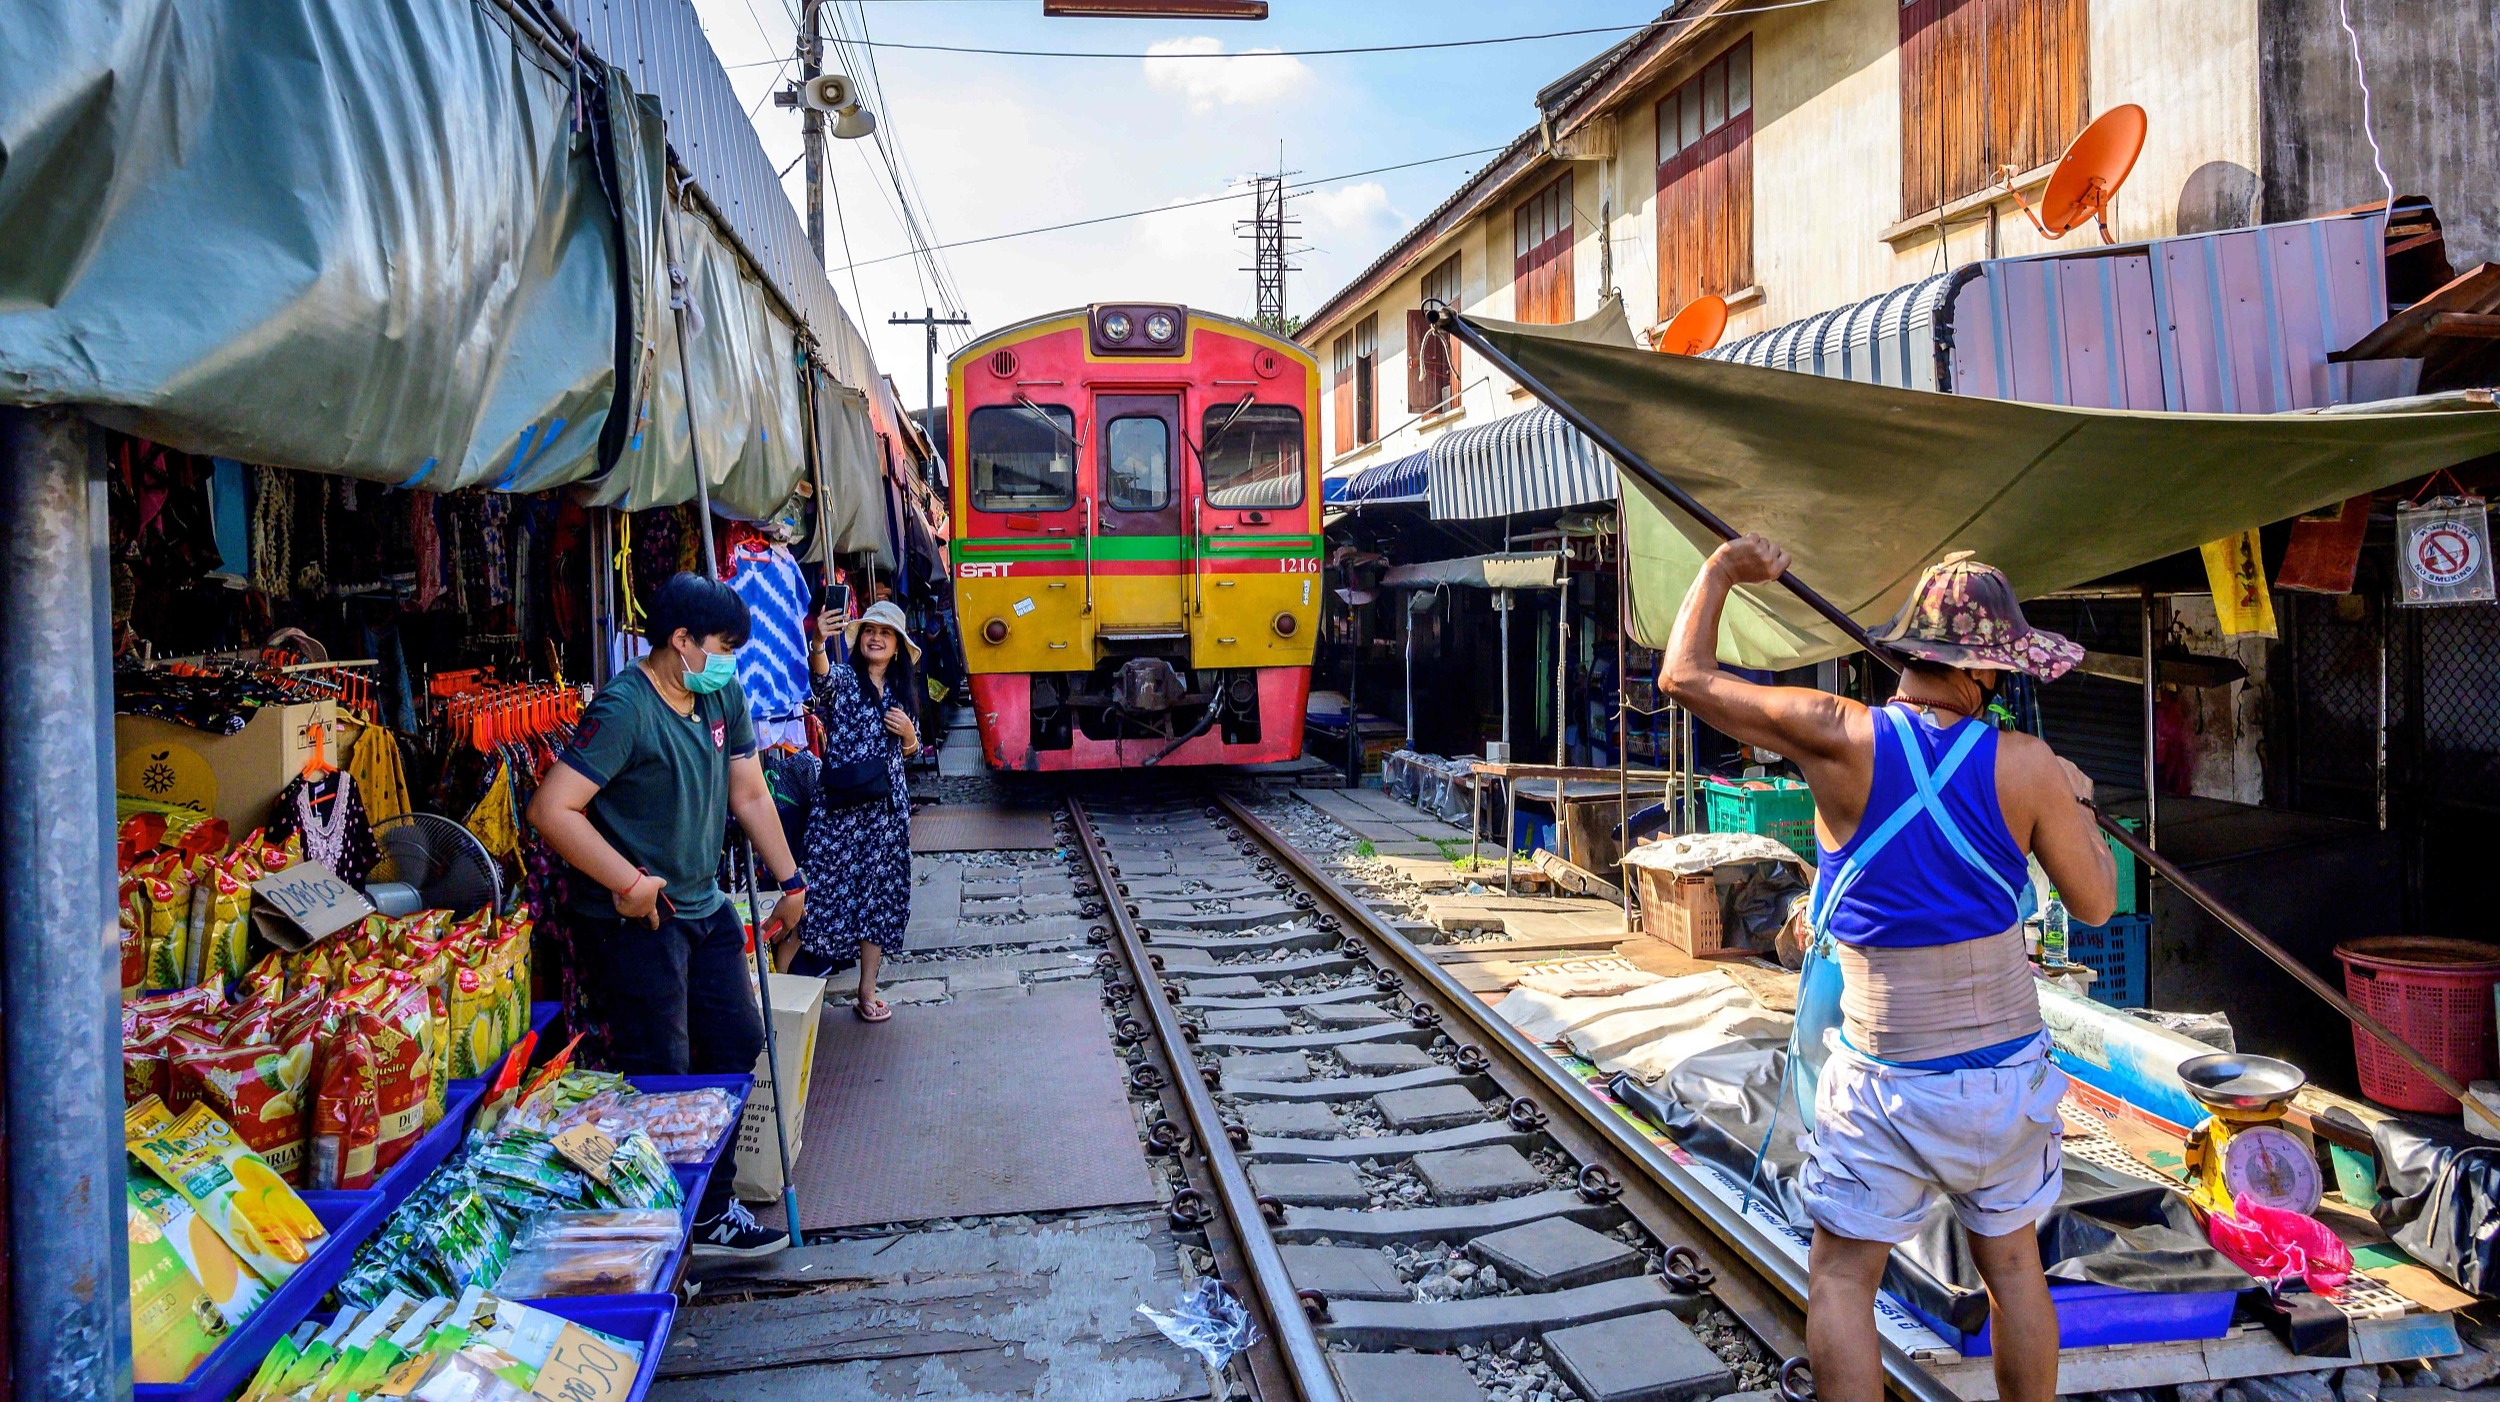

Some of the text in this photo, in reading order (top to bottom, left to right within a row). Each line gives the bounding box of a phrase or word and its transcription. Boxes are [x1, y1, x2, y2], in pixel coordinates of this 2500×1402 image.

[960, 562, 1013, 578] SRT
[1280, 557, 1317, 574] 1216
[2414, 563, 2472, 583] NO SMOKING
[747, 1113, 759, 1121] 100
[708, 1223, 739, 1245] N
